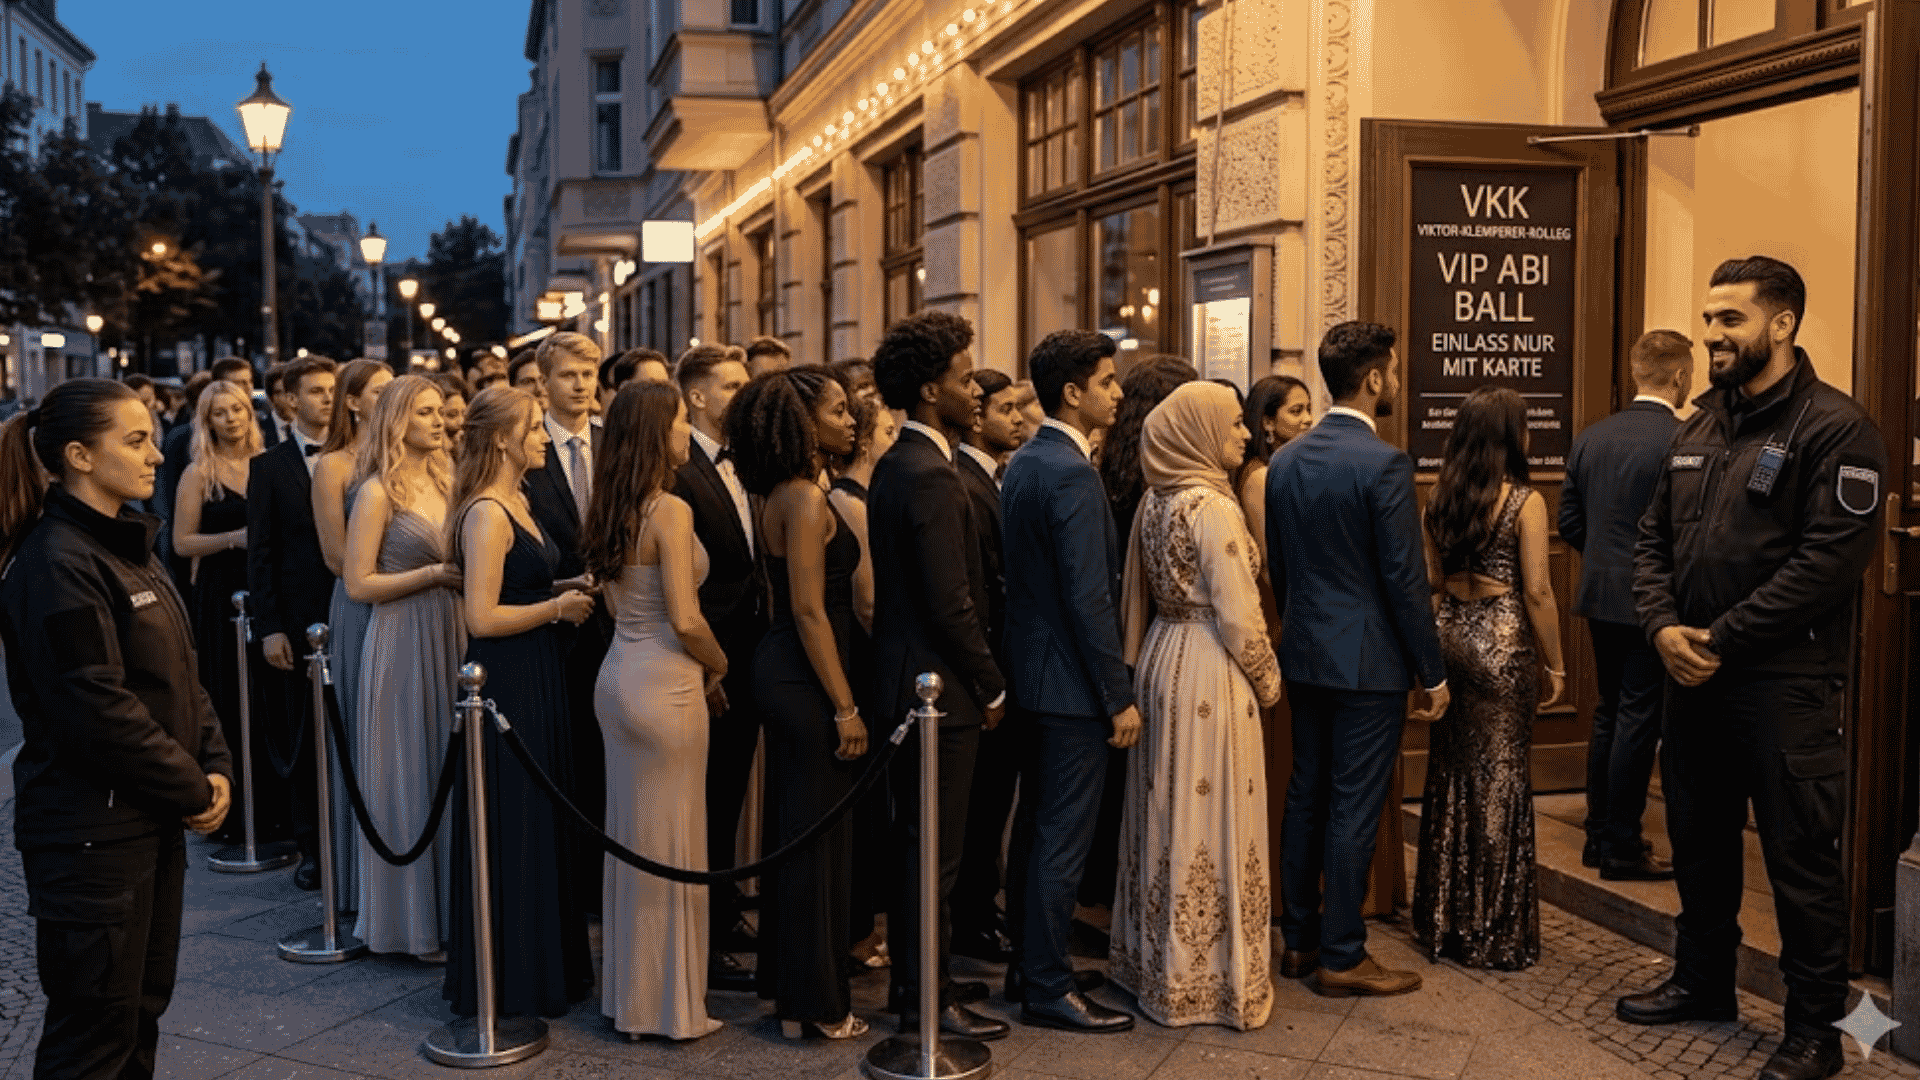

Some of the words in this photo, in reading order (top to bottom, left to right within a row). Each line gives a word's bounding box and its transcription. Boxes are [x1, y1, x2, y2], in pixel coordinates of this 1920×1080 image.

[1460, 183, 1530, 219] VKK
[1437, 251, 1489, 284] VIP
[1497, 253, 1549, 286] ABI
[1455, 290, 1535, 322] BALL
[1432, 332, 1509, 352] EINLASS
[1513, 334, 1555, 353] NUR
[1443, 357, 1478, 377] MIT
[1482, 357, 1543, 378] KARTE
